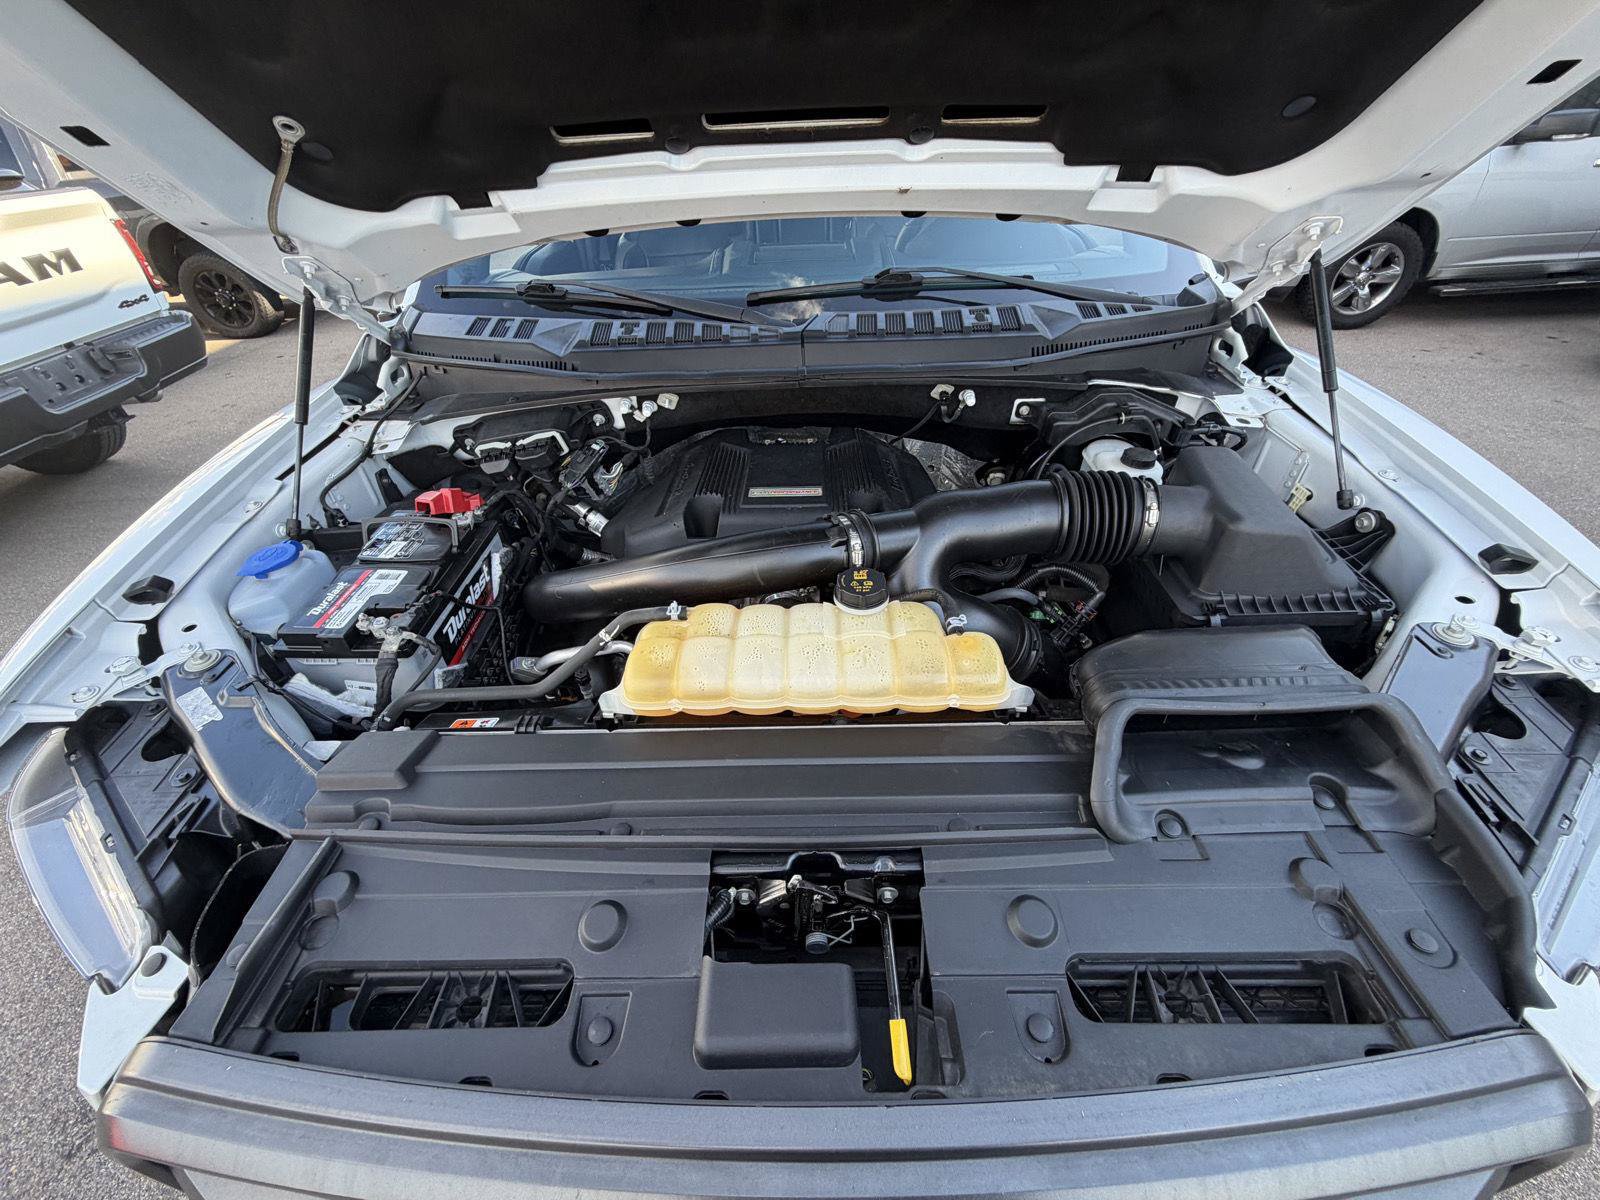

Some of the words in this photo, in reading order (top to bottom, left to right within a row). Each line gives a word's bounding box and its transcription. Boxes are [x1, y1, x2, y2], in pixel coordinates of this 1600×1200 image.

[118, 293, 150, 309] 4x4
[306, 581, 349, 617] Duralast
[442, 564, 491, 643] Duralast
